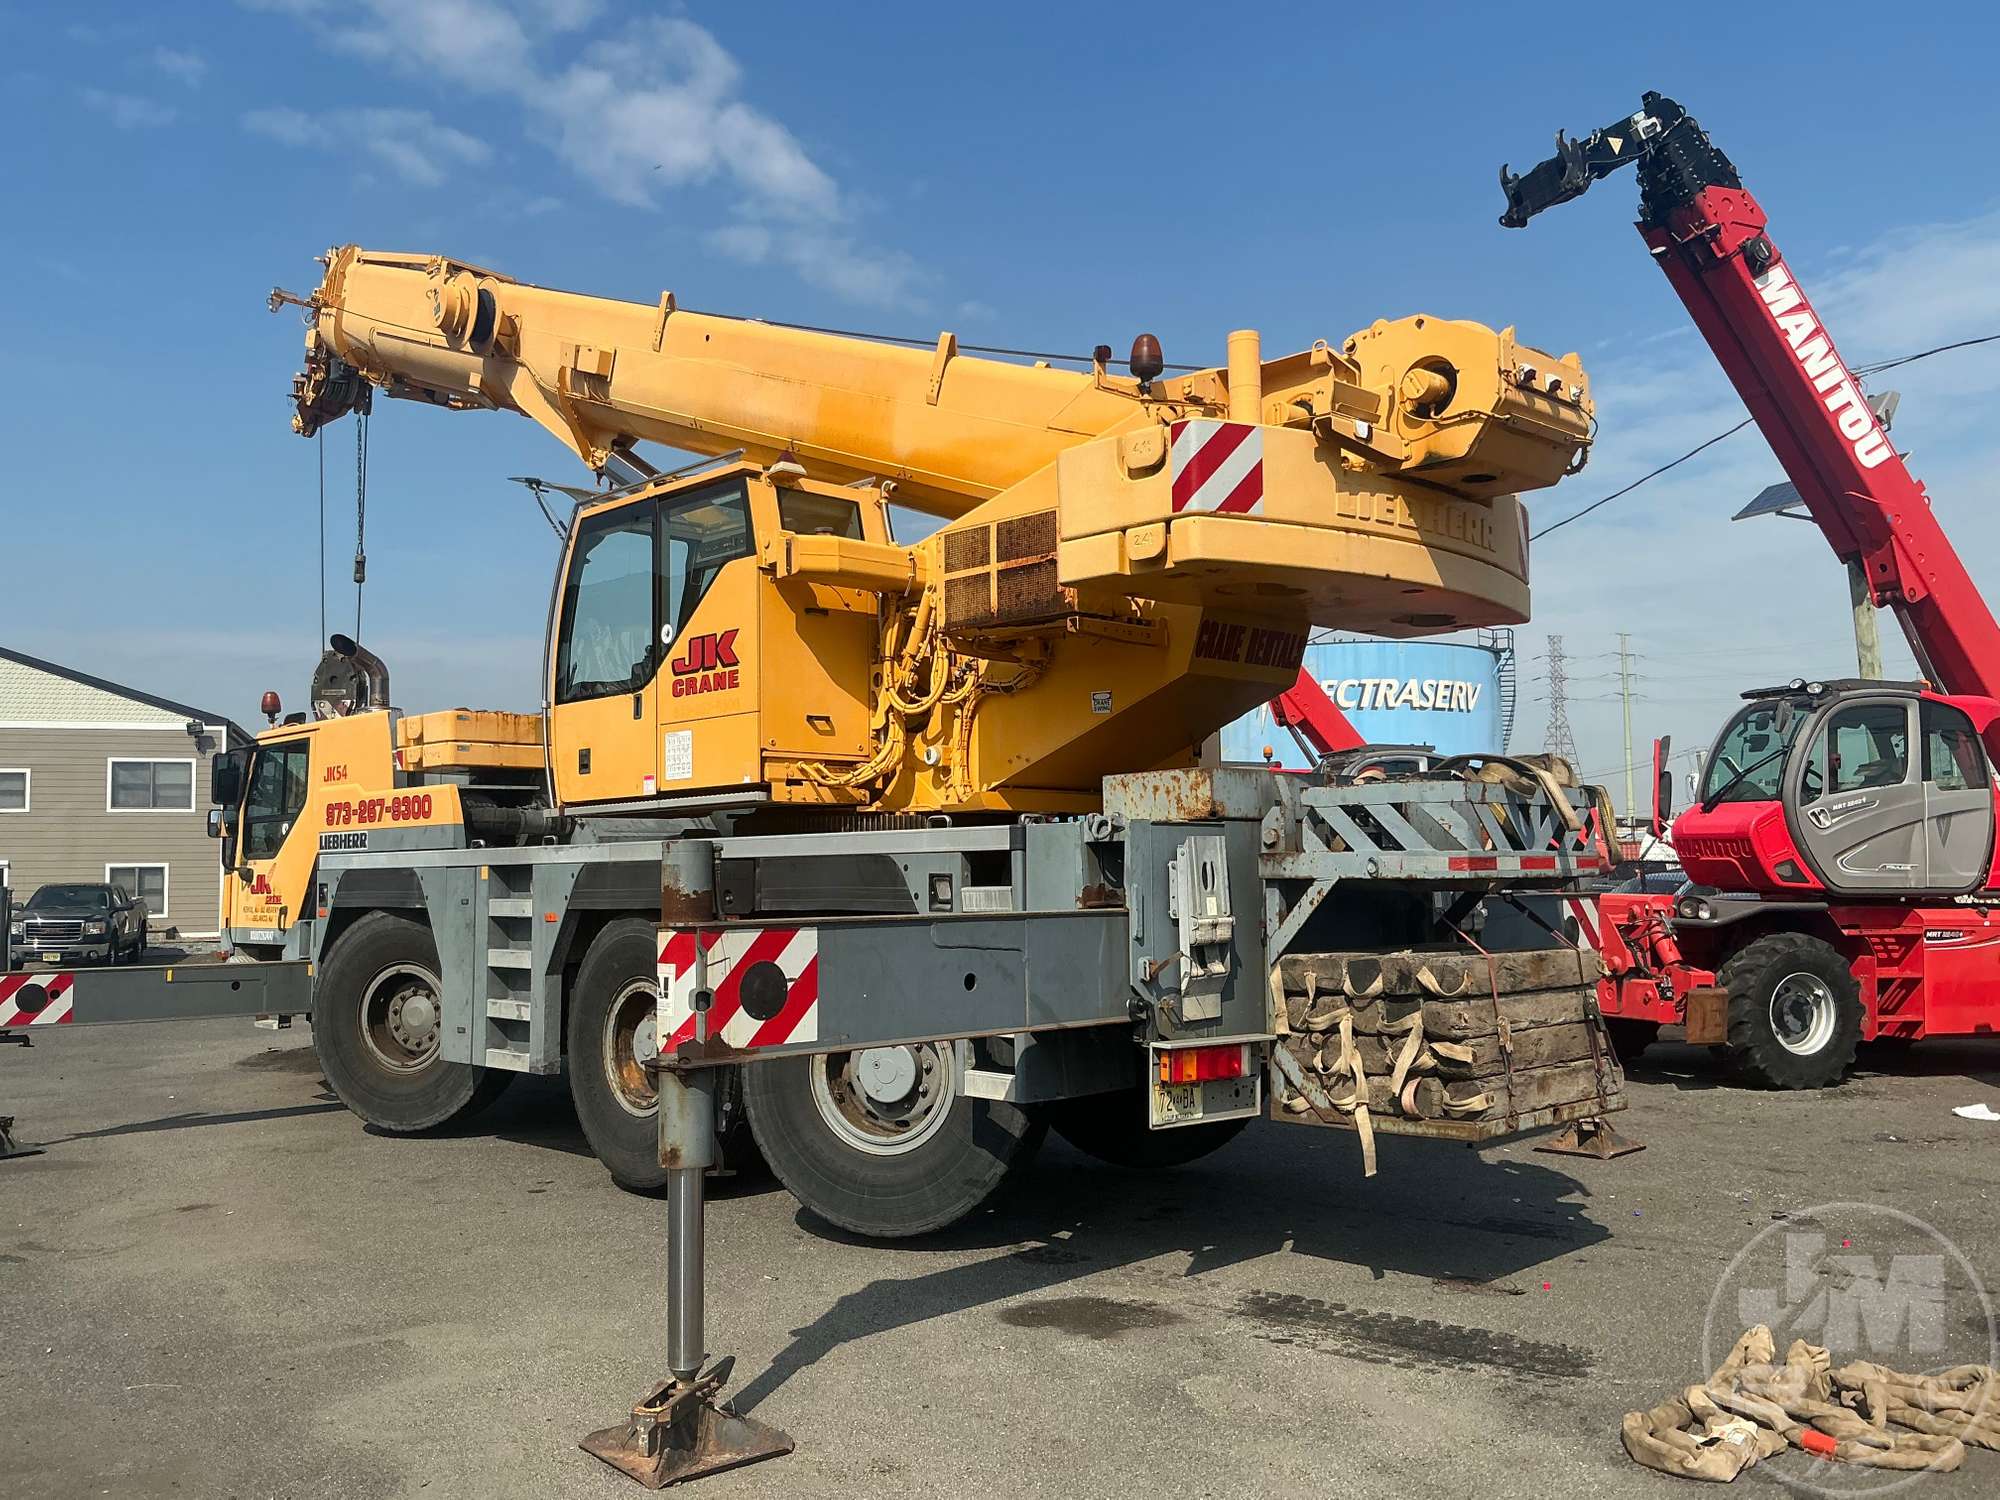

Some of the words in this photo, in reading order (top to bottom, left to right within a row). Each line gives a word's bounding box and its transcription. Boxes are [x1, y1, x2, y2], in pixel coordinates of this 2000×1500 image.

[1754, 262, 1894, 469] MANITOU
[672, 628, 740, 677] JK
[1195, 618, 1248, 663] CRANE
[672, 669, 740, 698] CRANE
[323, 765, 348, 783] JK54
[319, 832, 368, 850] LIEBHERR
